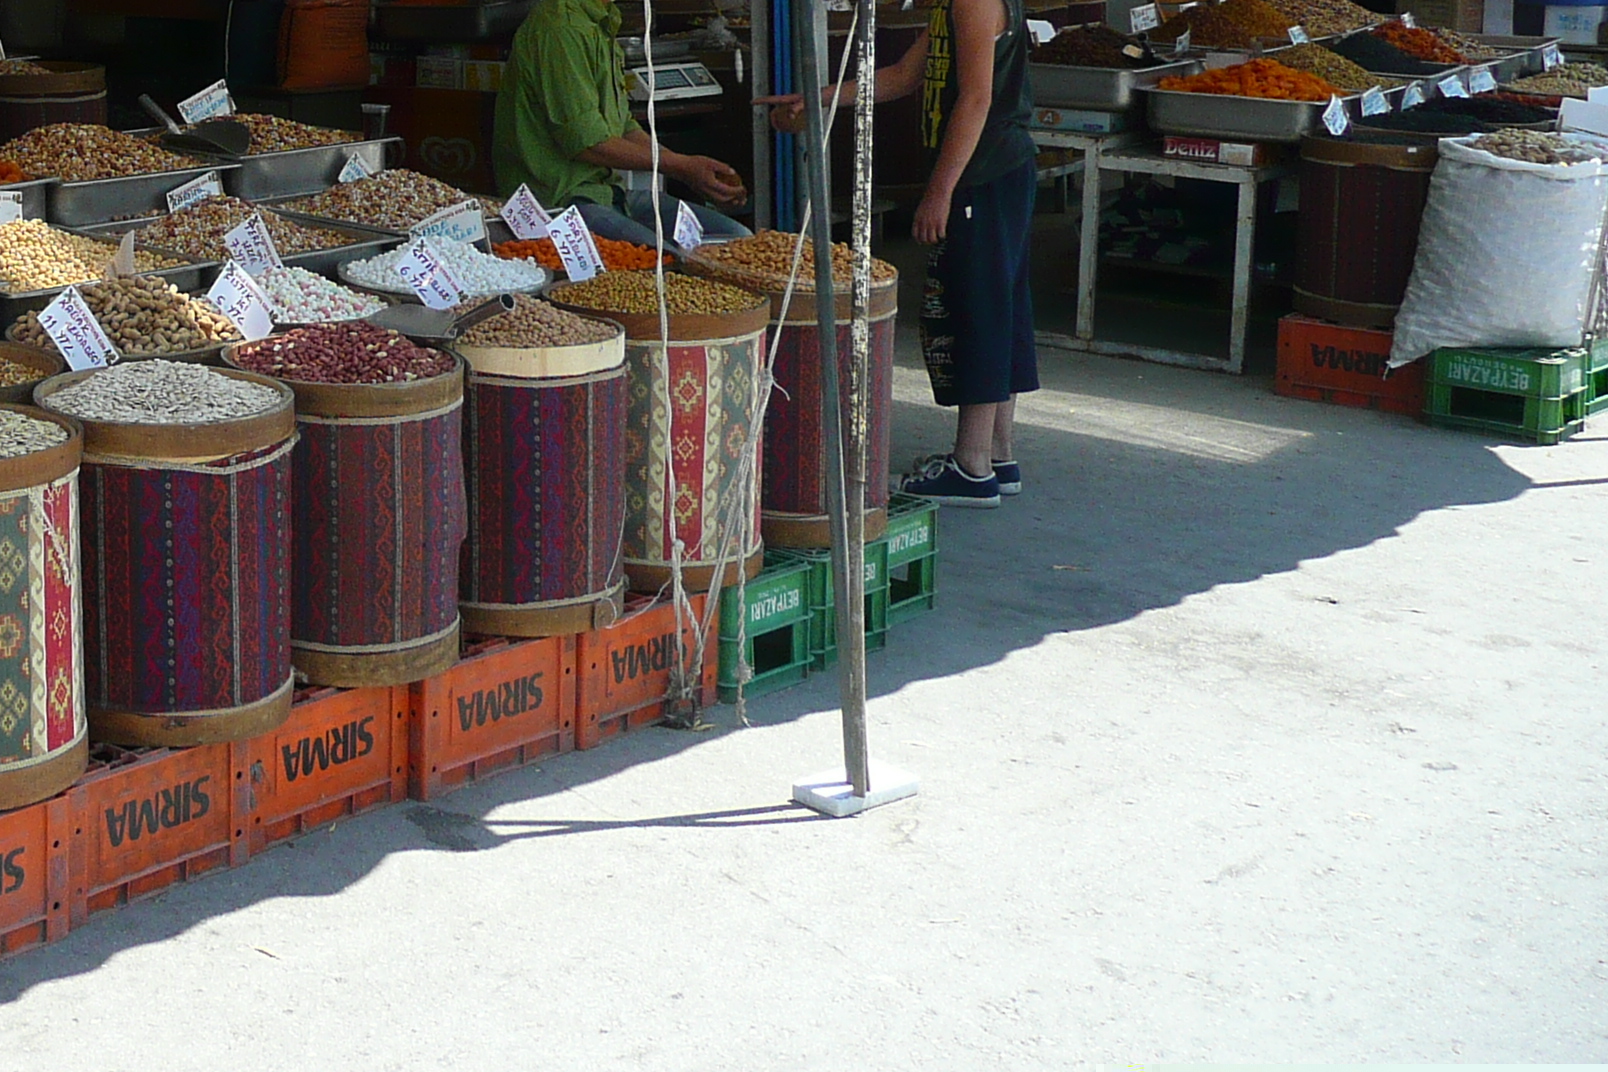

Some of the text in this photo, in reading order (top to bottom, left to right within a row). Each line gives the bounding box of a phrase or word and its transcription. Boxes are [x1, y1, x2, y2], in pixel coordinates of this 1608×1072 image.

[1164, 138, 1216, 158] Deniz
[399, 266, 410, 275] 6
[1447, 362, 1530, 390] BEYPAZARI
[751, 589, 800, 622] BEYPAZARI
[457, 670, 545, 733] SIRMA
[280, 714, 375, 782] SIRMA
[103, 774, 211, 848] SIRMA
